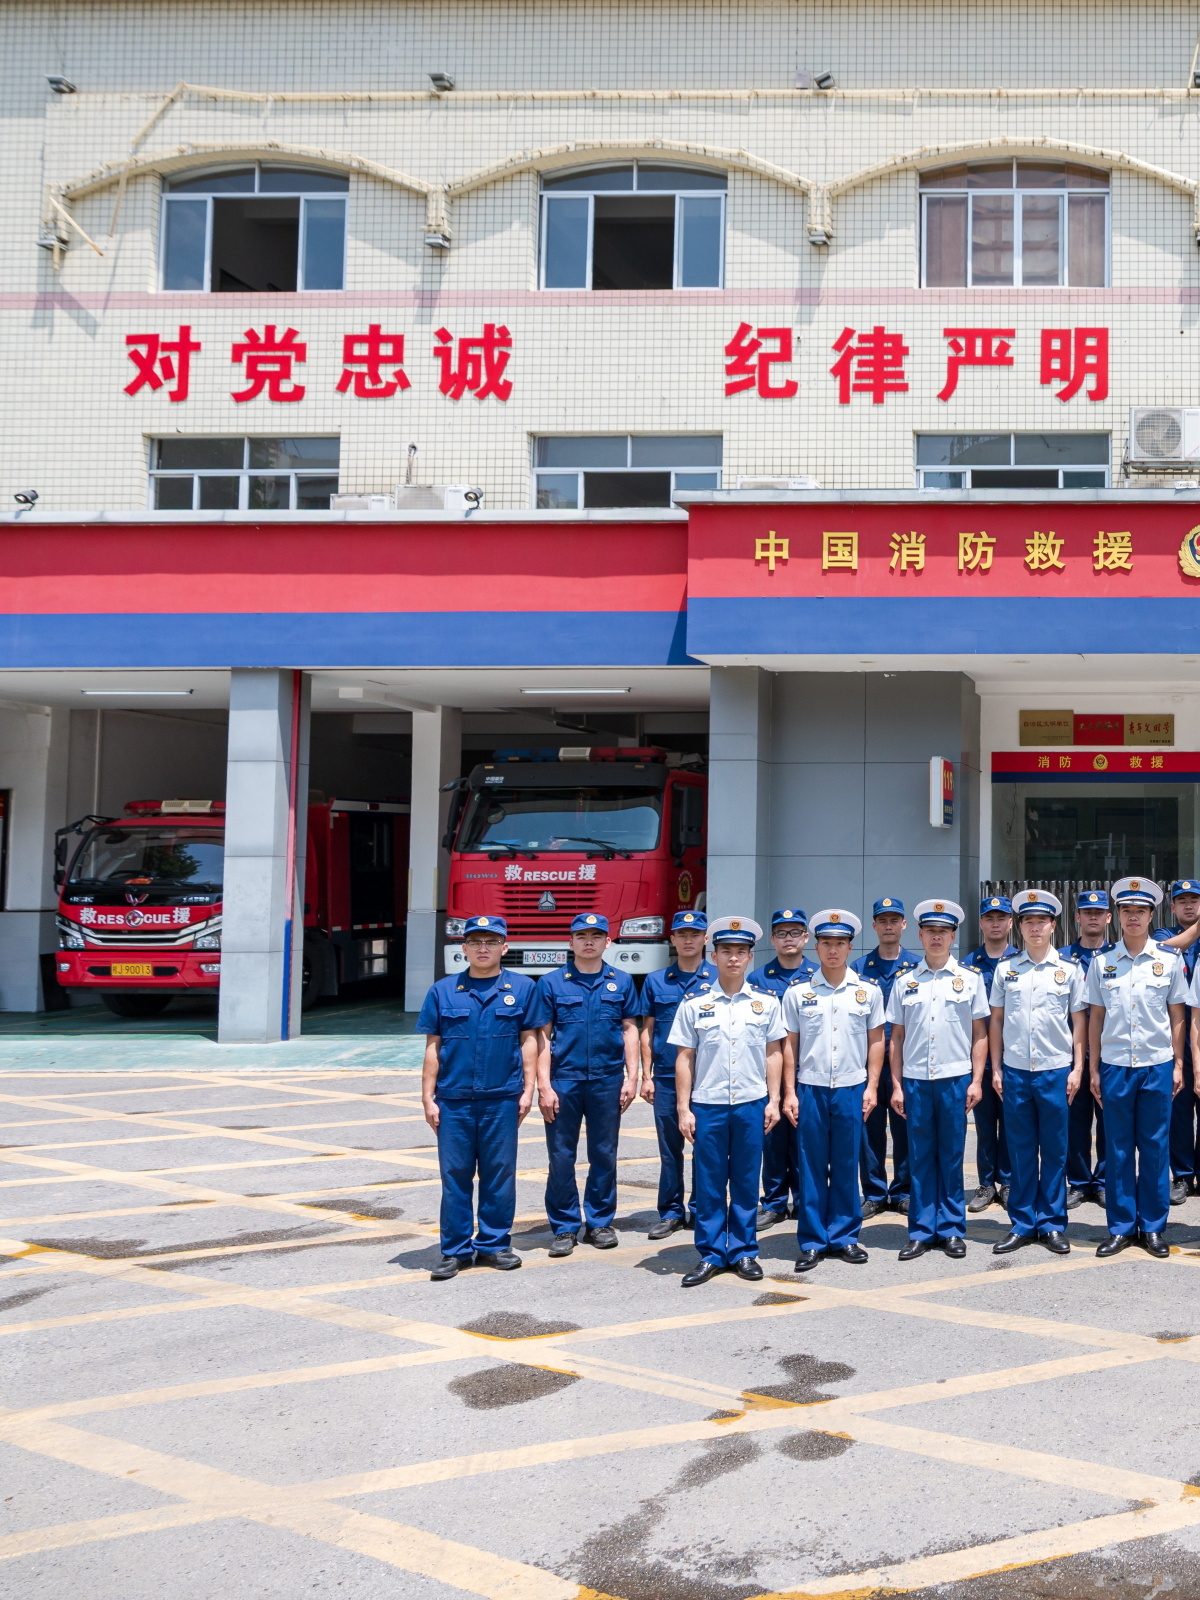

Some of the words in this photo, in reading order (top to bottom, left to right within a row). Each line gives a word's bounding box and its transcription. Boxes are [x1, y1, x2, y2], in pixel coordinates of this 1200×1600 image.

[124, 324, 513, 402] 对党忠诚
[725, 322, 1109, 404] 纪律严明
[754, 530, 1134, 571] 中国消防救援
[1038, 756, 1072, 769] 消防
[1129, 756, 1164, 769] 救援
[504, 864, 523, 881] 救
[524, 871, 577, 881] RESCUE
[578, 863, 597, 881] 援
[80, 907, 97, 924] 救
[98, 915, 125, 925] RES
[143, 914, 171, 924] CUE
[173, 907, 191, 924] 援
